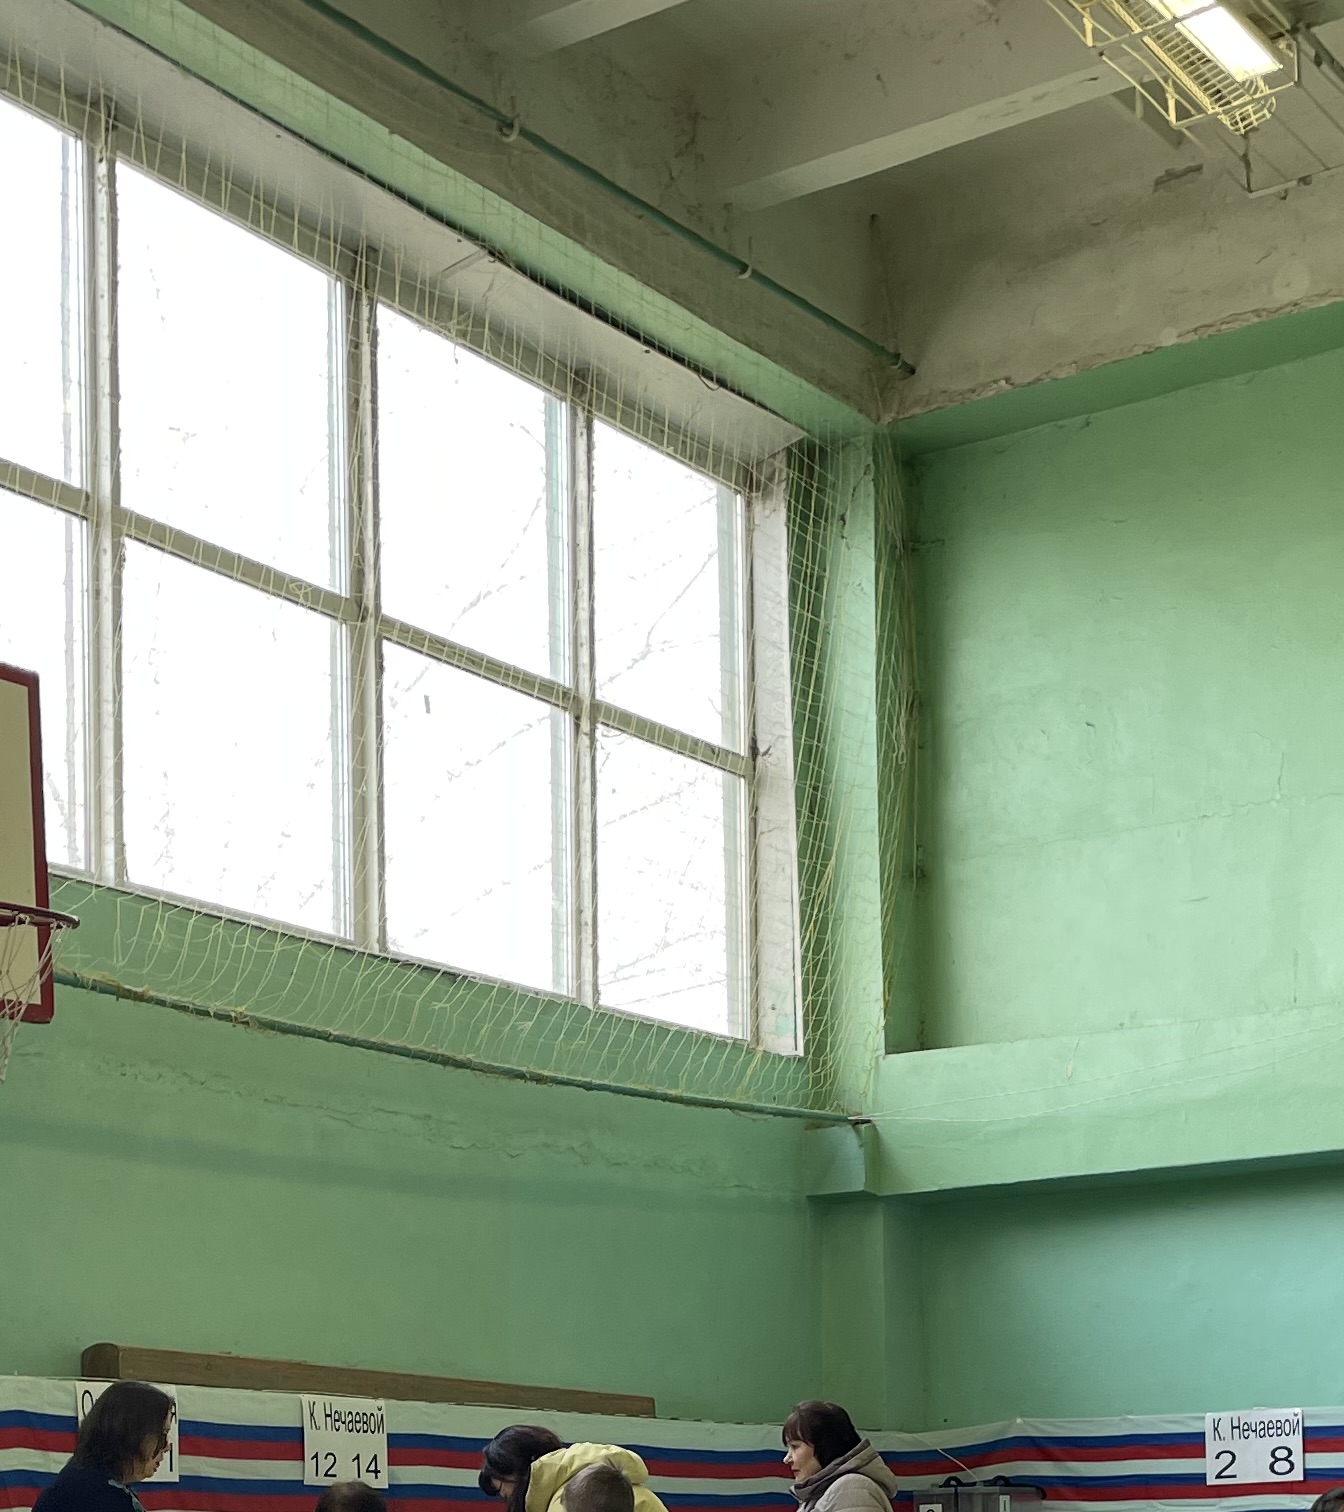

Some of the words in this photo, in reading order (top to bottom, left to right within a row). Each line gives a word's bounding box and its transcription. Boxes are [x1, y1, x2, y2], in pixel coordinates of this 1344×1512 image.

[308, 1401, 320, 1430] К.
[323, 1402, 384, 1434] Нечаевой
[1213, 1418, 1225, 1441] К.
[1231, 1412, 1300, 1440] Нечаевой
[311, 1452, 337, 1477] 12
[352, 1453, 381, 1479] 14
[1215, 1450, 1237, 1479] 2
[1269, 1446, 1295, 1475] 8
